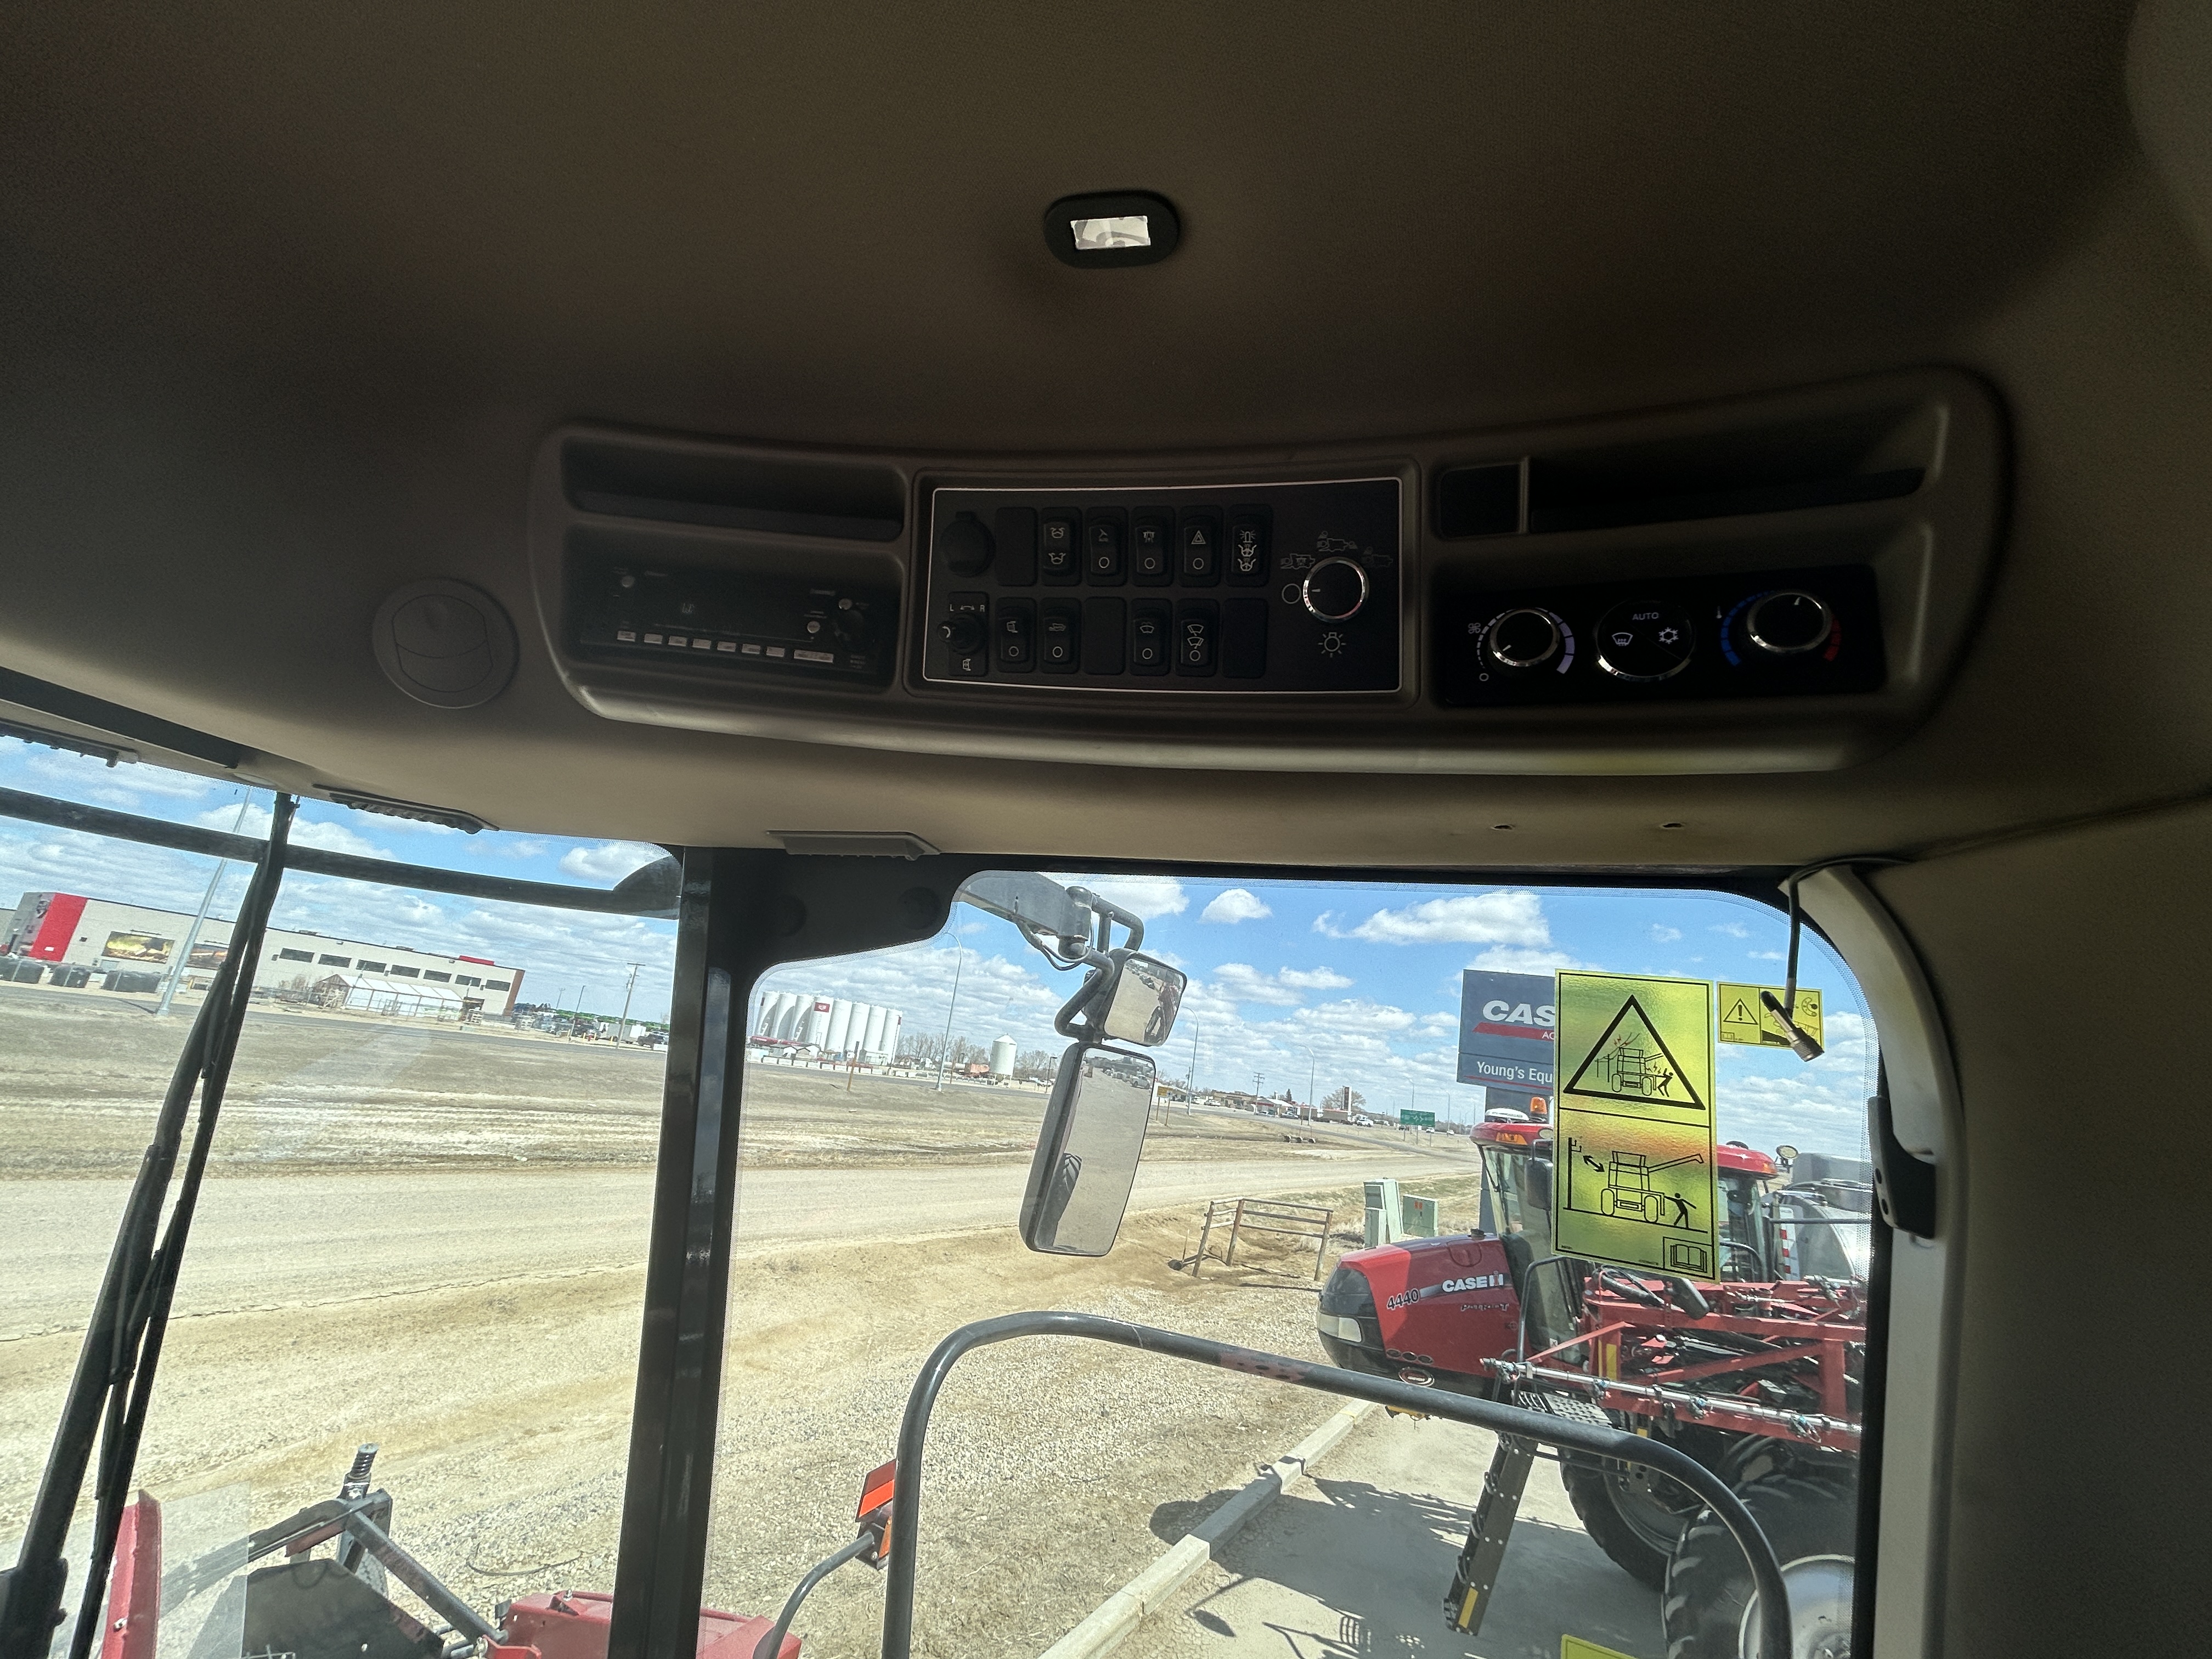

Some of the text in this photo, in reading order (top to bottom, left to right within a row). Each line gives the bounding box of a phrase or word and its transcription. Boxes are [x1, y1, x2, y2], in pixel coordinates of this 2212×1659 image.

[1477, 1062, 1525, 1080] Young's
[1442, 1276, 1487, 1292] CASE
[1386, 1289, 1420, 1311] 4440
